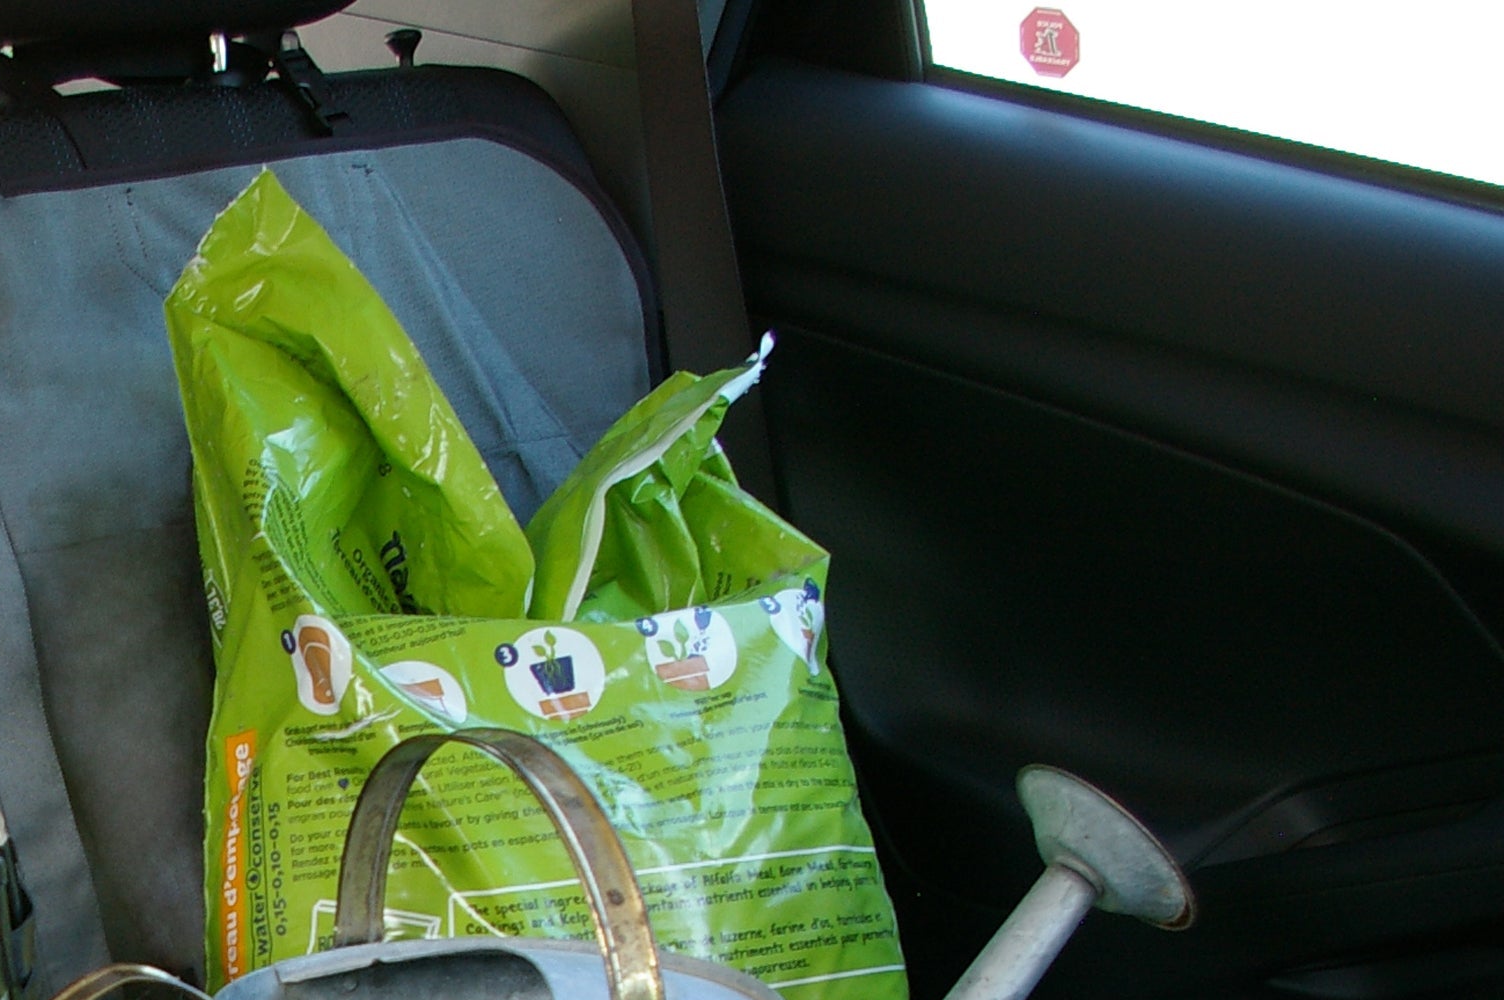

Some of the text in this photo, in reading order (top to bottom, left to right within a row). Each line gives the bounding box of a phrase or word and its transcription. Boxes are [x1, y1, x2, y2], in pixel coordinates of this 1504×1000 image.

[503, 647, 513, 664] 3
[467, 815, 480, 825] by
[495, 898, 539, 919] special
[253, 893, 269, 957] water
[559, 911, 589, 928] Kelp
